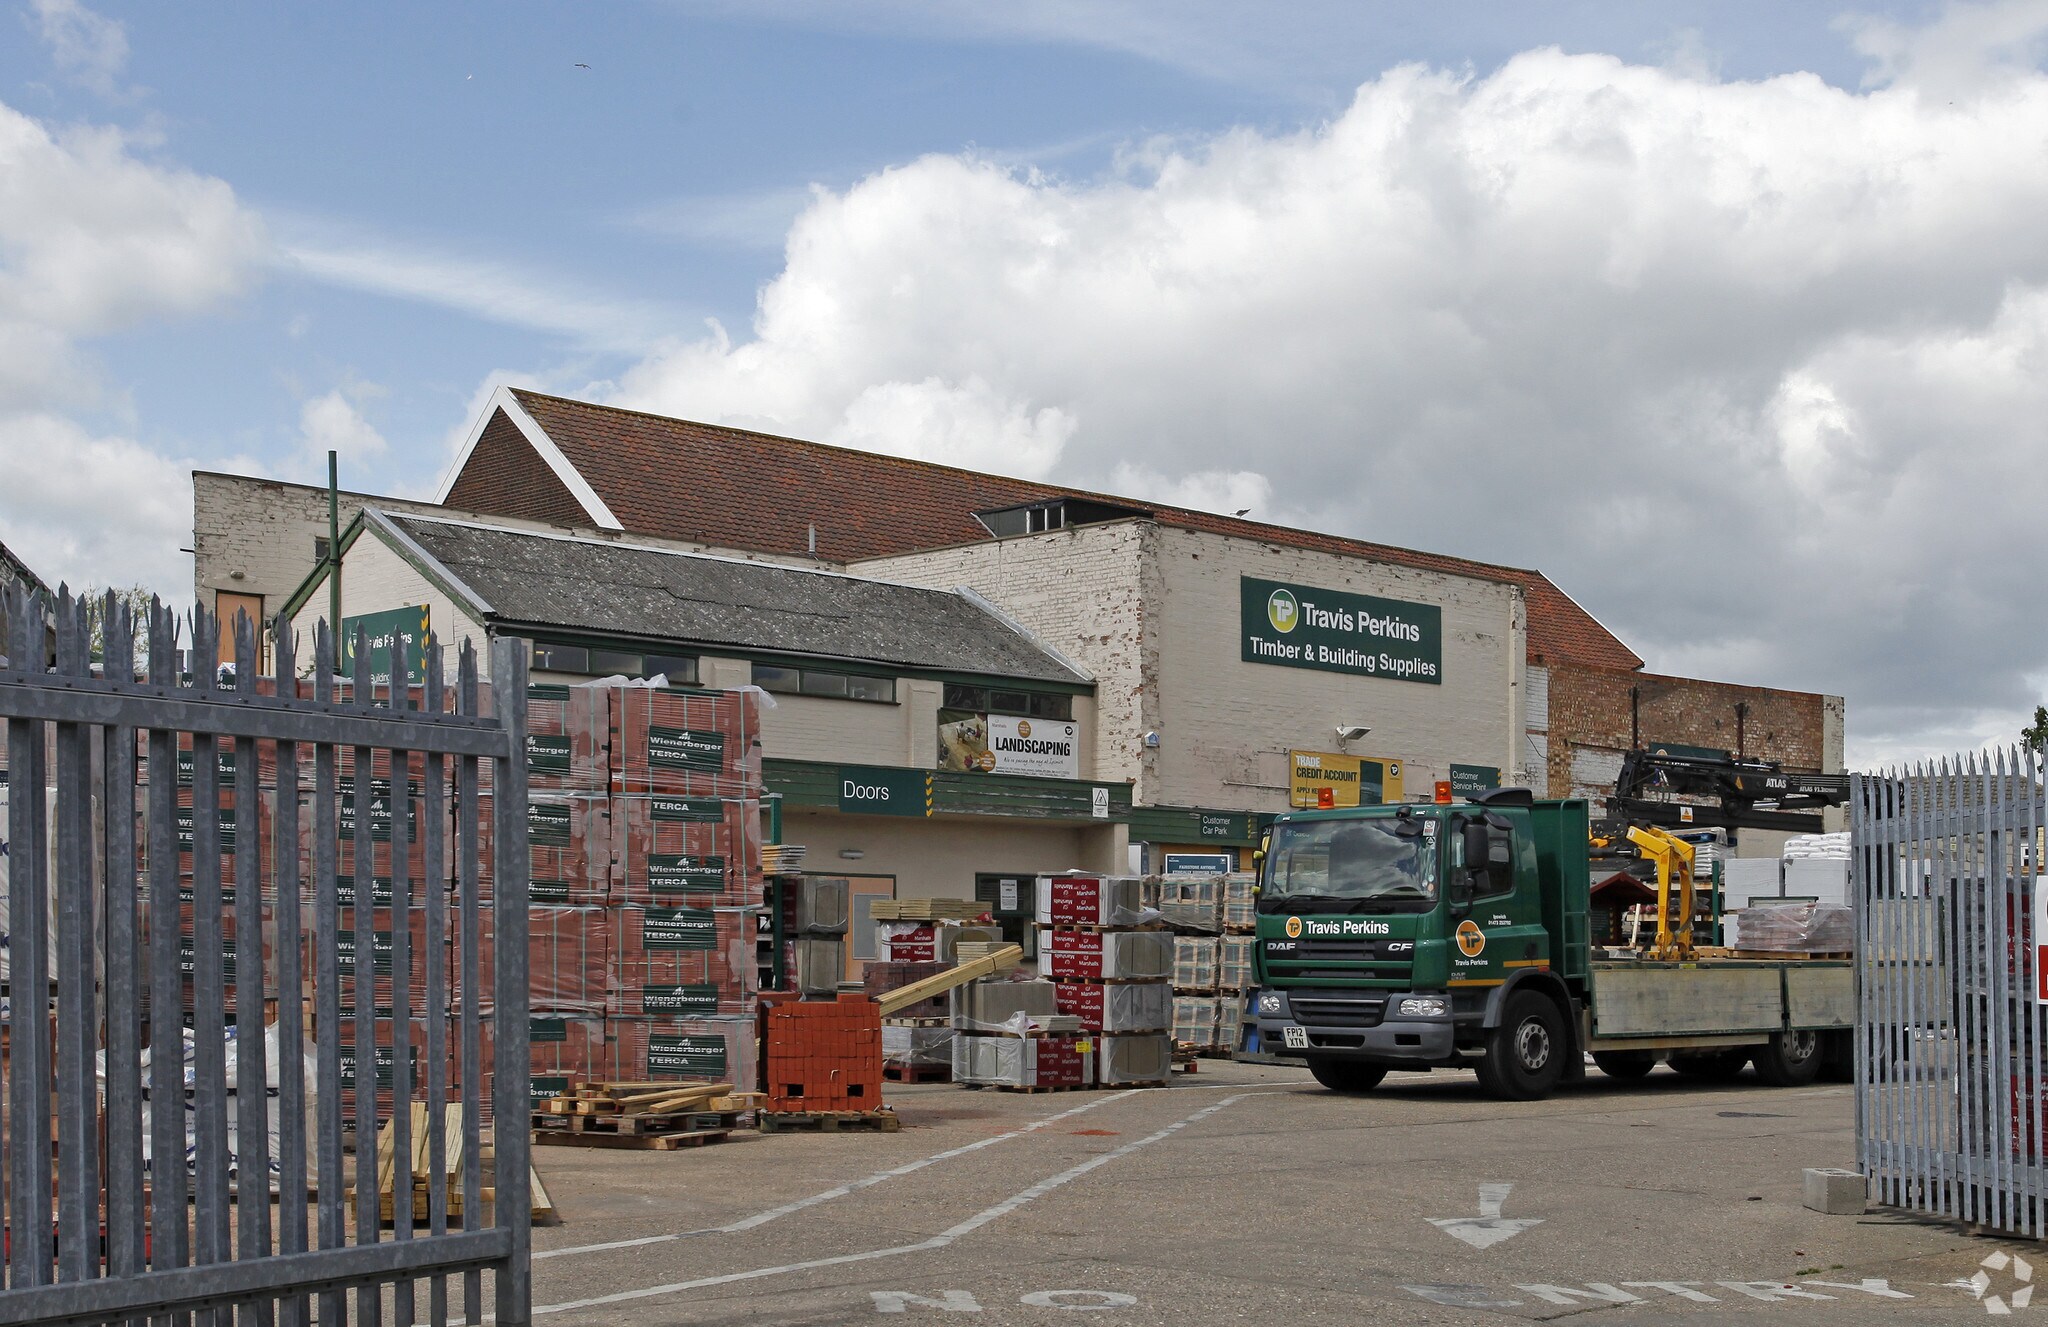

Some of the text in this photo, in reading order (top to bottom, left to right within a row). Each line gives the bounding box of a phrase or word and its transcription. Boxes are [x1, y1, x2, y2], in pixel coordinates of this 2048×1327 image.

[1302, 603, 1420, 642] Travis Perkins
[1250, 636, 1436, 677] Timber & Building Supplies
[650, 736, 723, 750] Wienerberger
[995, 736, 1071, 756] LANDSCAPING
[649, 749, 688, 760] TERCA
[1296, 755, 1320, 767] TRADE
[1297, 767, 1357, 782] CREDIT ACCOUNT
[1452, 771, 1478, 780] Customer
[1452, 781, 1486, 791] Service Point
[1766, 778, 1787, 789] ATLAS
[844, 780, 890, 801] Doors
[652, 801, 690, 812] TERCA
[1202, 815, 1231, 825] Customer
[1202, 826, 1228, 835] Car Park
[649, 865, 723, 875] Wienerberger
[649, 878, 689, 886] TERCA
[645, 919, 714, 929] Wienerberger
[1306, 921, 1340, 934] Travis
[1343, 920, 1389, 934] Perkins
[644, 931, 682, 940] TERCA
[1388, 943, 1413, 952] CF
[1286, 1028, 1304, 1037] FP12
[1290, 1038, 1305, 1046] XTN
[650, 1044, 725, 1055] Wienerberger
[649, 1056, 689, 1065] TERCA
[869, 1289, 1138, 1313] NO
